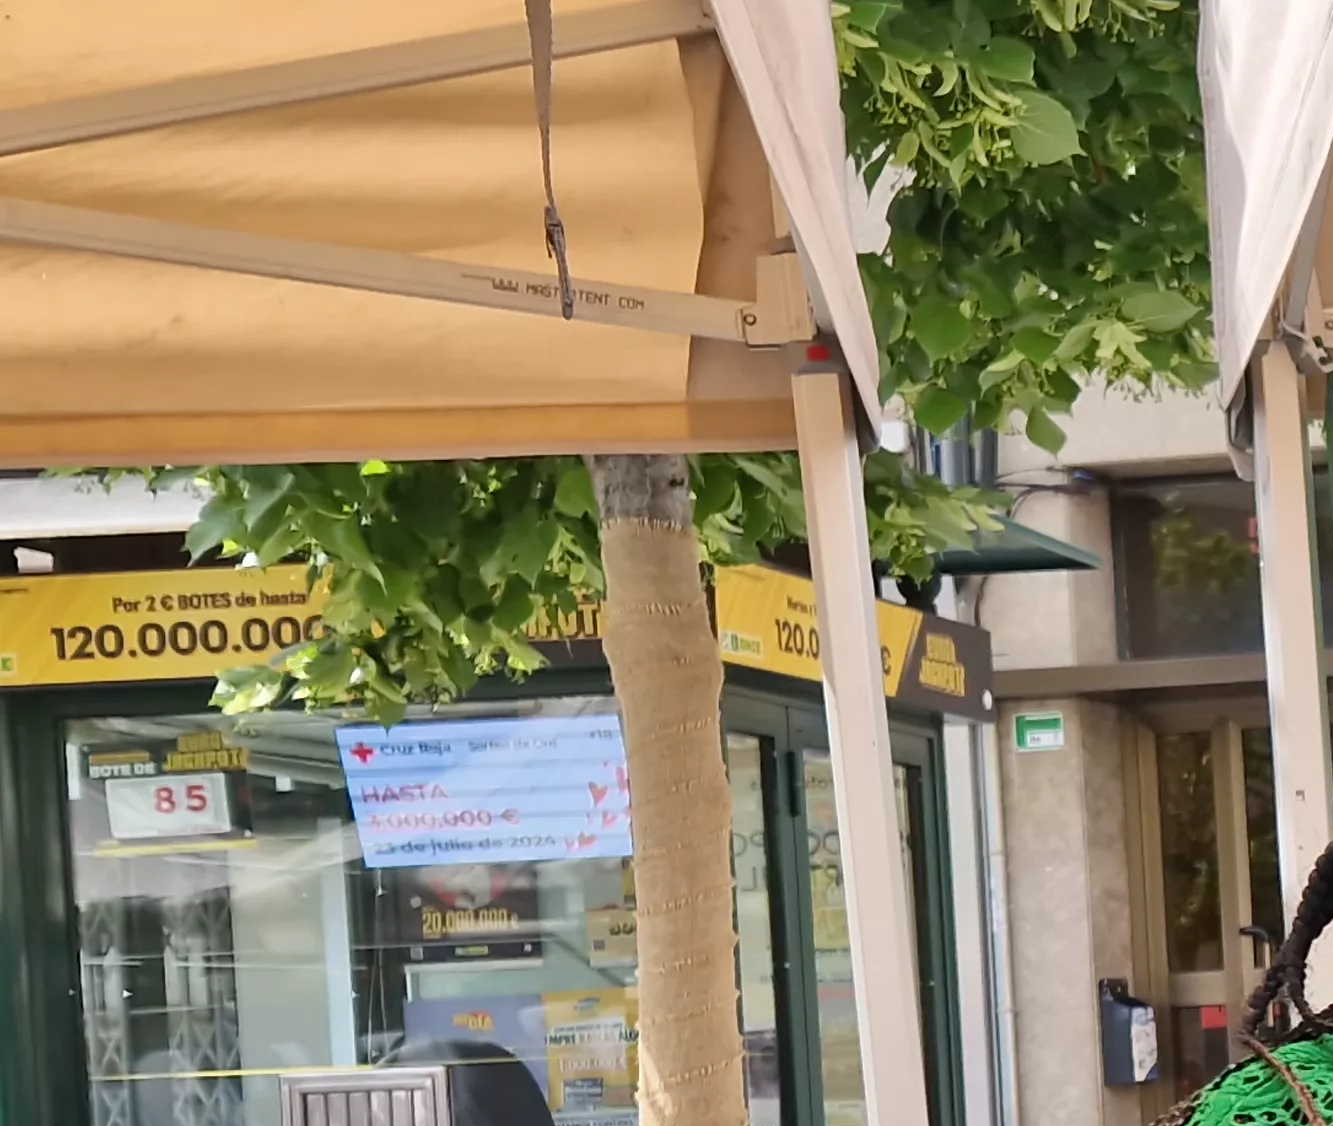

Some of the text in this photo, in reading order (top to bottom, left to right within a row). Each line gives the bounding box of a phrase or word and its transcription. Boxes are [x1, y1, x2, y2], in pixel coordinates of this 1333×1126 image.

[112, 589, 307, 613] Por 2 € BOTES de hasta
[380, 743, 414, 756] Cruz
[361, 784, 448, 803] HASTA
[400, 839, 427, 853] de
[430, 837, 473, 856] julio
